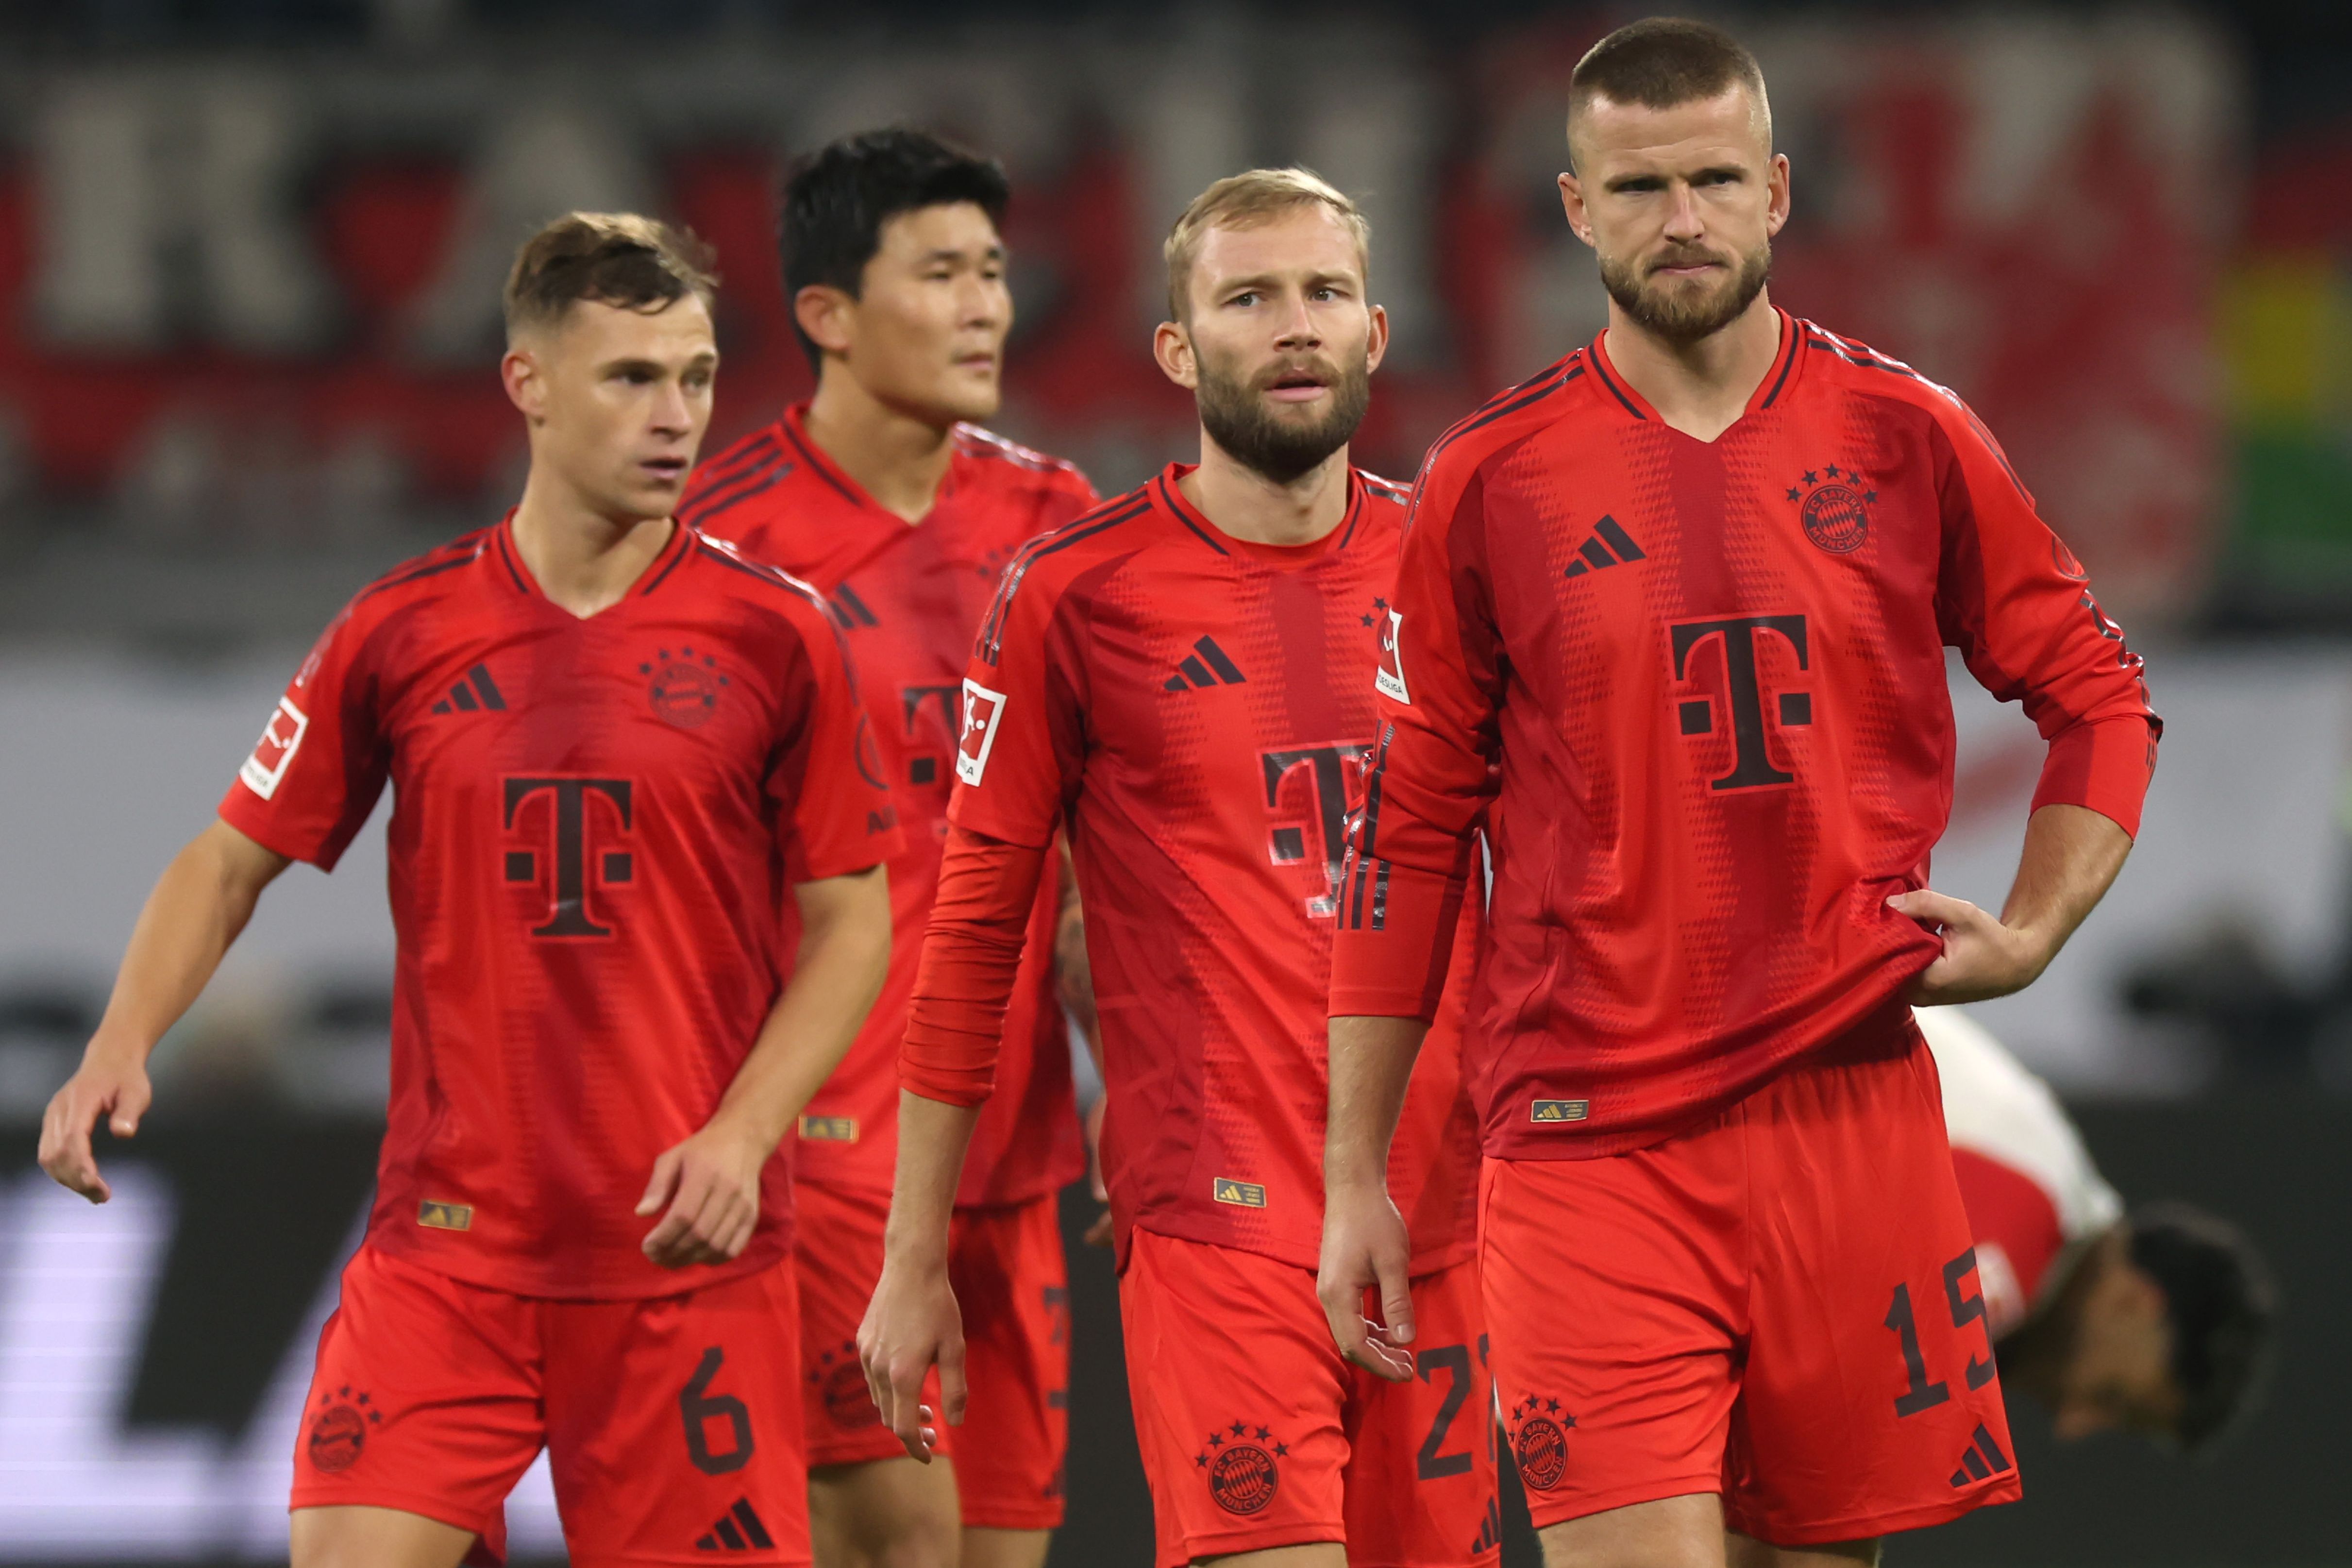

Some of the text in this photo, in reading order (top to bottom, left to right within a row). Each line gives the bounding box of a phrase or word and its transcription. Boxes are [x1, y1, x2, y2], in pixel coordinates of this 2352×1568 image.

[1807, 490, 1863, 515] FC BAYERN
[1671, 614, 1812, 791] T
[504, 778, 632, 936] T
[1883, 1245, 1996, 1418] 15
[679, 1346, 755, 1476] 6
[1226, 1449, 1271, 1472] BAYERN
[1525, 1422, 1561, 1446] BAYERN
